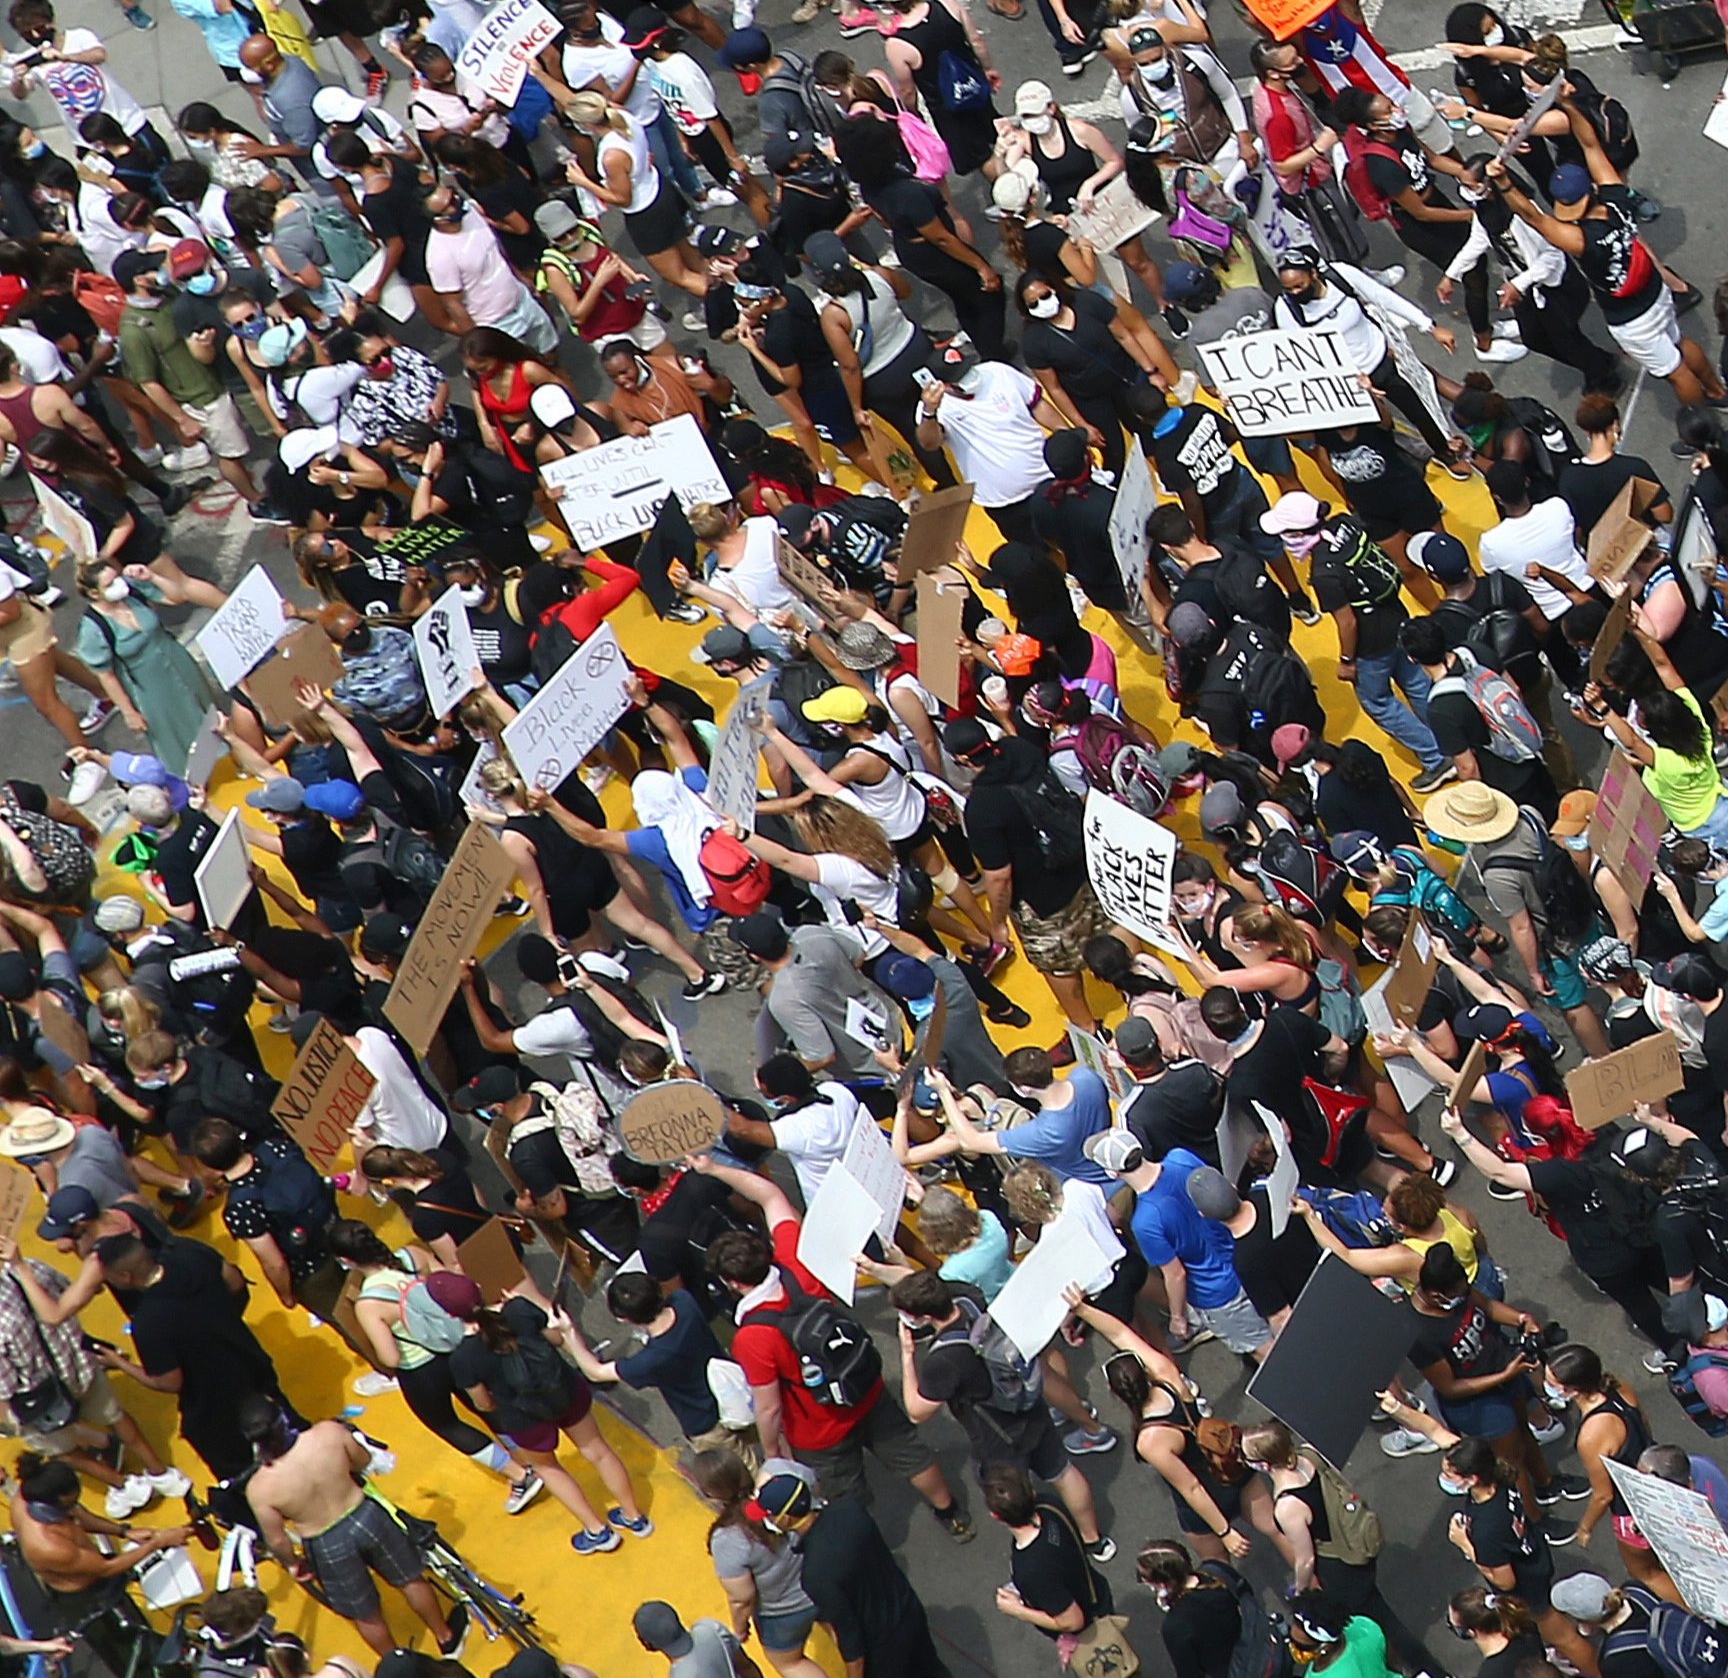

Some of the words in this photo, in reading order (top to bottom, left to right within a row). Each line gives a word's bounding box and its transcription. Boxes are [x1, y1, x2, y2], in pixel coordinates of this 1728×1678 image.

[488, 19, 555, 97] VIOLENCE
[1207, 348, 1243, 384] I
[1227, 374, 1373, 427] BREATHE
[584, 443, 631, 471] LIVES
[373, 527, 415, 553] BLACK
[398, 524, 441, 553] LIVES
[406, 528, 465, 566] MATTER
[575, 509, 630, 546] BLACK
[219, 607, 266, 645] TRANS
[520, 679, 588, 752] Black
[1091, 816, 1102, 843] for
[1103, 840, 1123, 920] BLACK
[1120, 848, 1146, 924] LIVES
[1140, 848, 1167, 939] MATTER
[396, 954, 432, 1004] THE
[421, 824, 493, 956] MOVEMENT
[280, 1093, 303, 1124] NO
[298, 1038, 345, 1103] JUSTICE
[306, 1124, 332, 1159] NO
[325, 1060, 374, 1134] PEACE
[622, 1108, 713, 1152] BREONNA
[648, 1126, 719, 1162] TAYLOR
